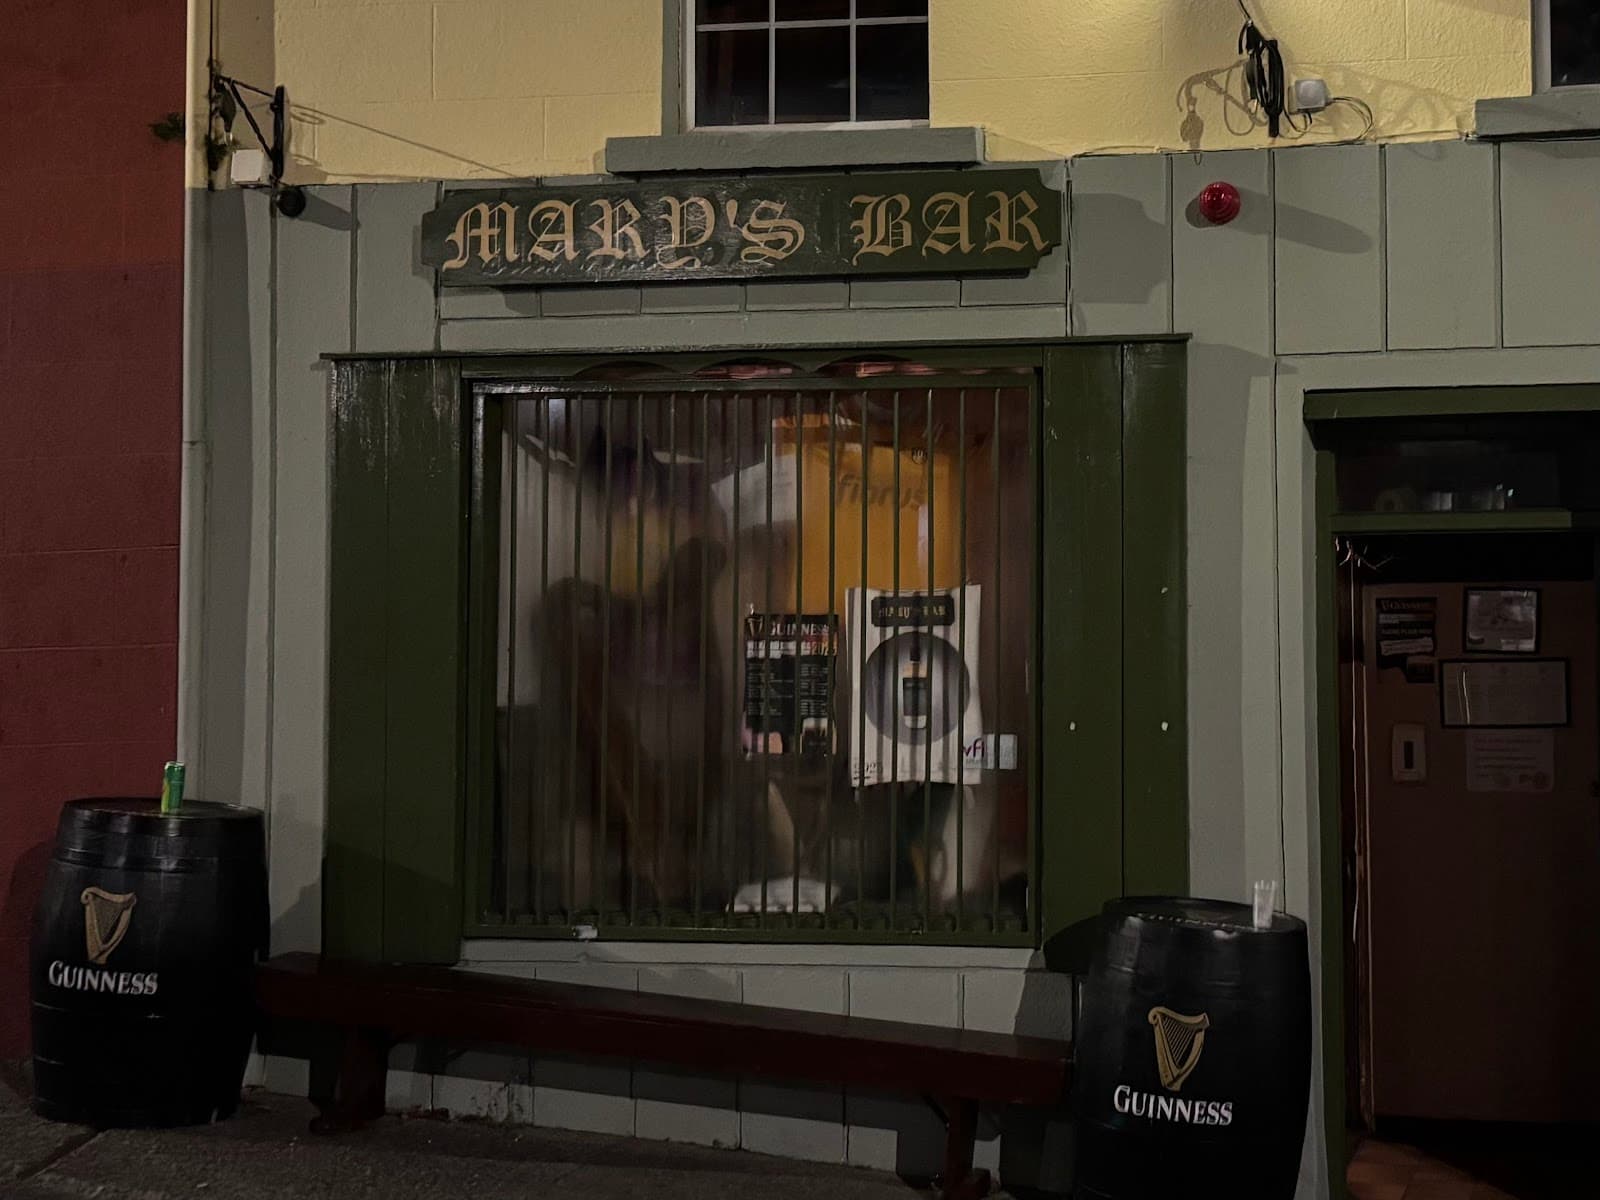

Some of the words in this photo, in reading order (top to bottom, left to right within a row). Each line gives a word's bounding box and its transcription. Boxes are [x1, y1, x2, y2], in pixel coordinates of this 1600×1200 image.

[442, 194, 806, 272] MARY'S
[849, 189, 1050, 267] BAR
[48, 959, 160, 995] GUINNESS
[1113, 1084, 1234, 1127] GUINNESS
